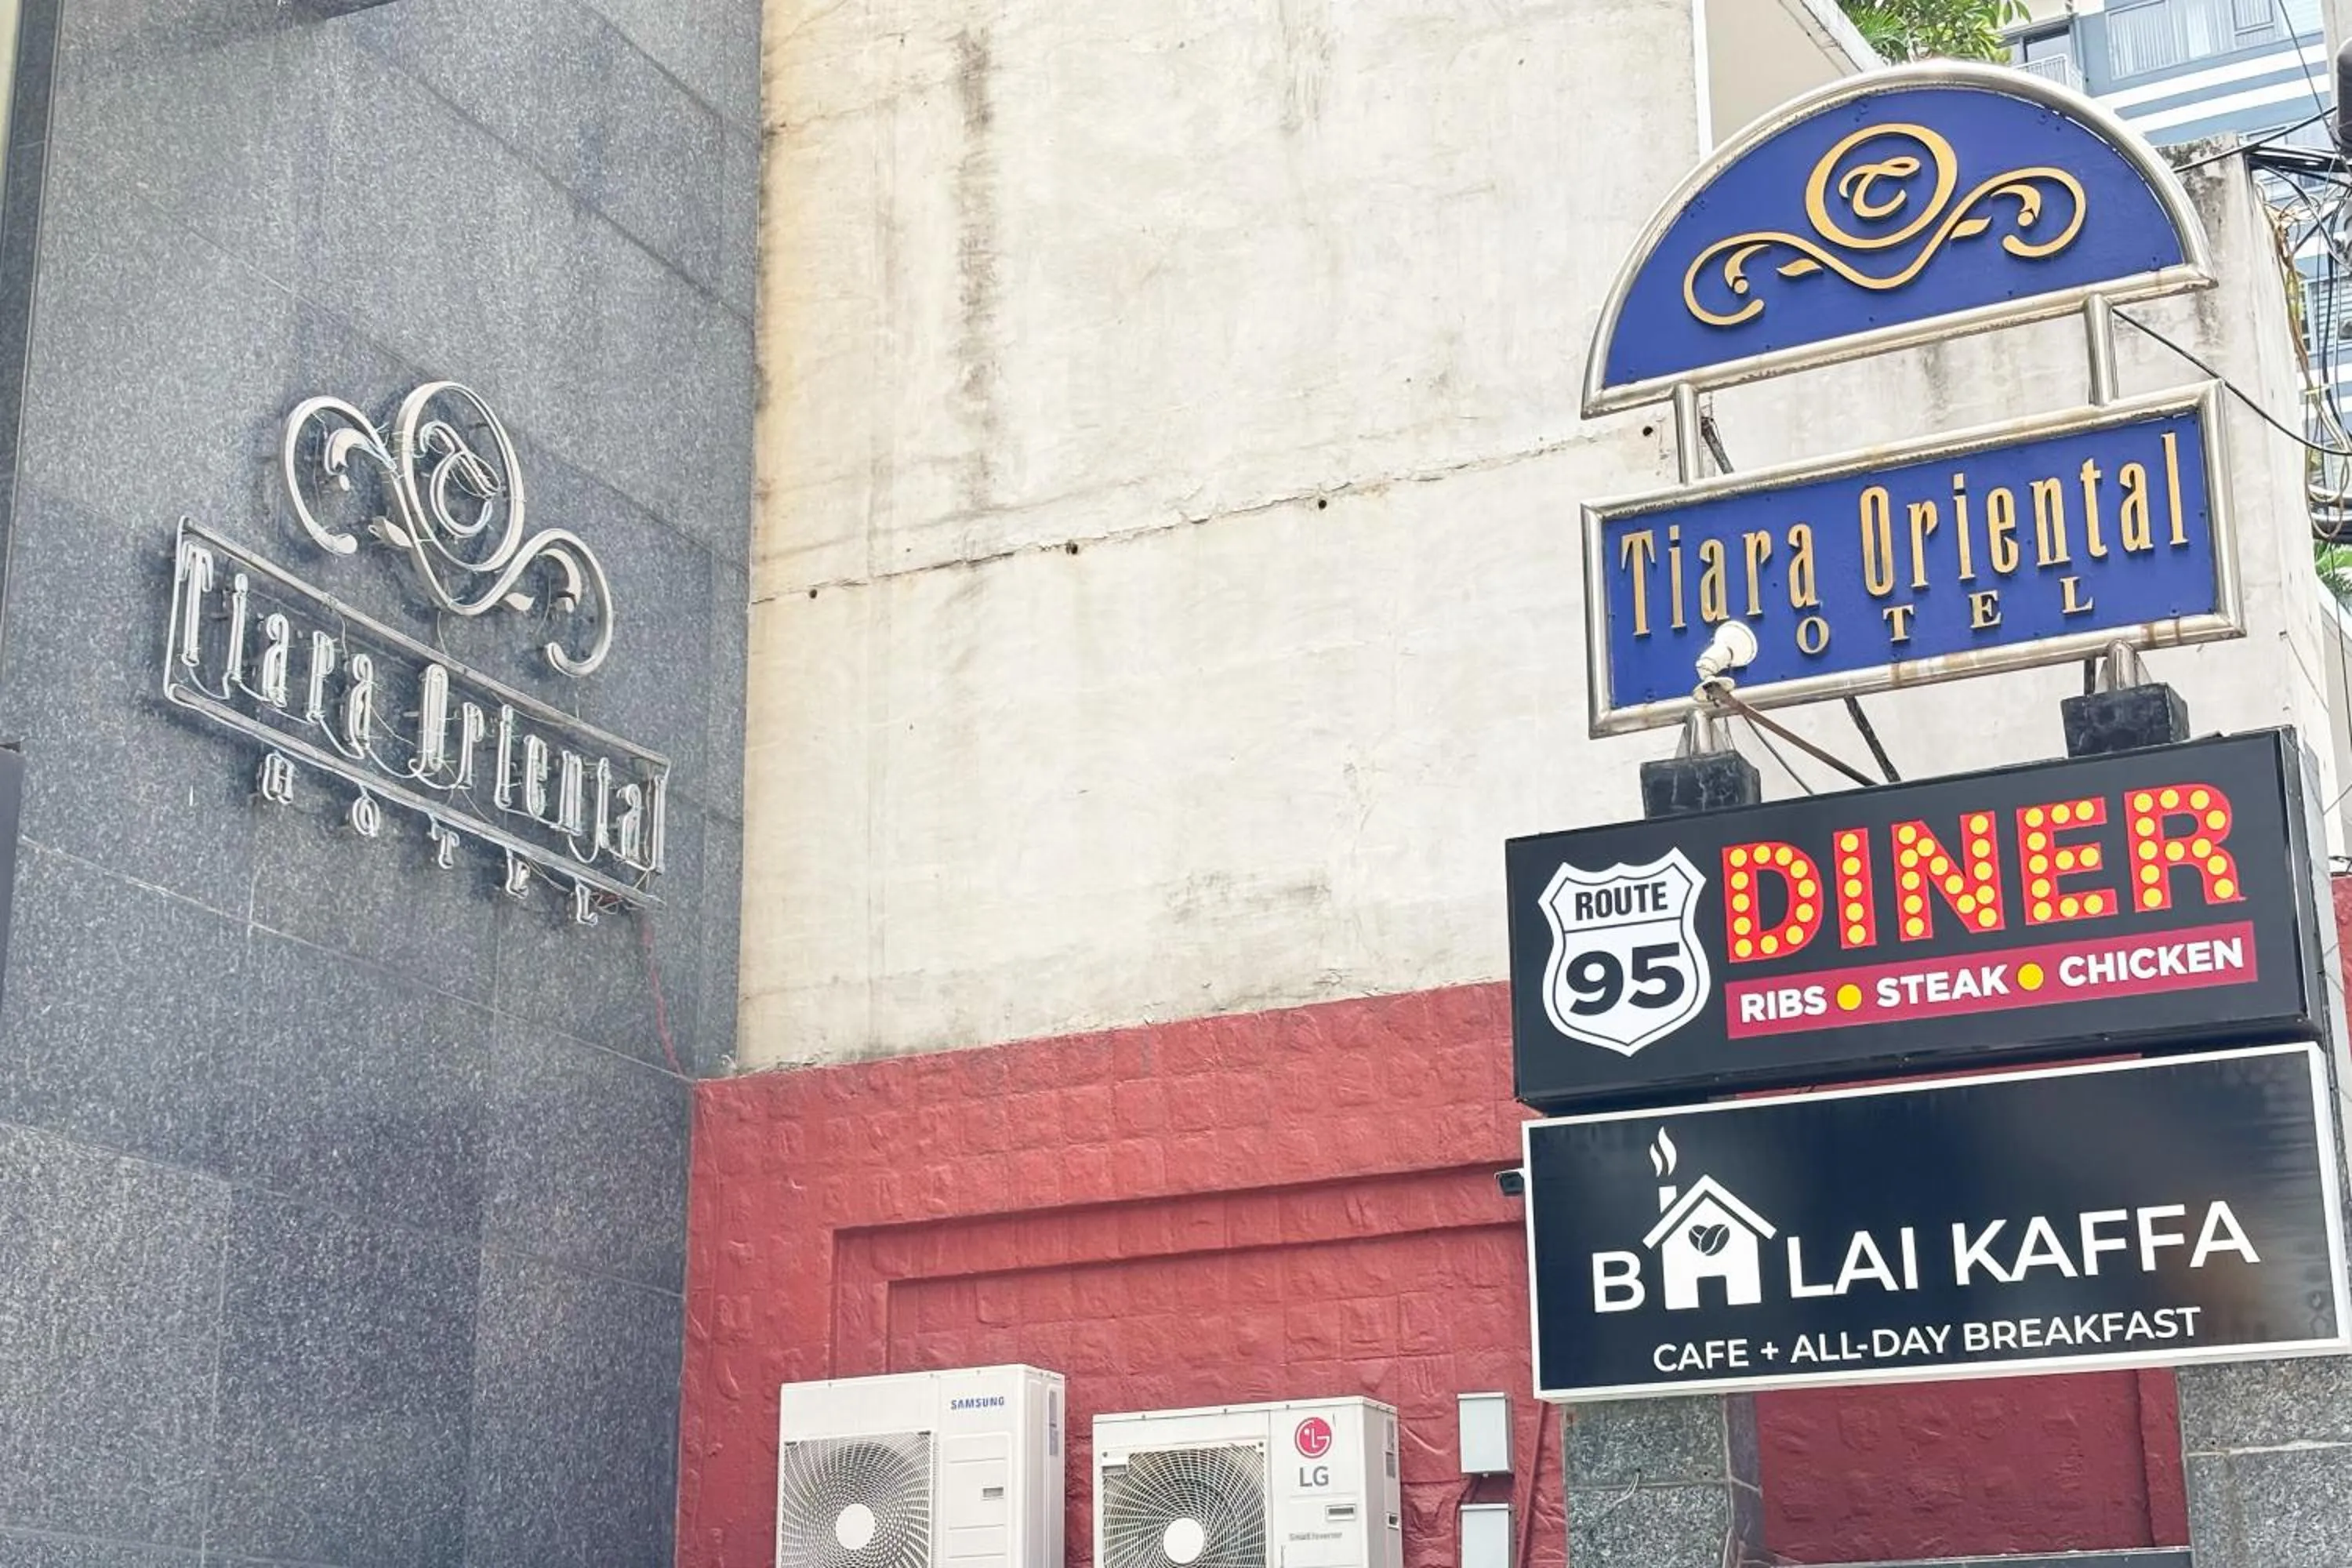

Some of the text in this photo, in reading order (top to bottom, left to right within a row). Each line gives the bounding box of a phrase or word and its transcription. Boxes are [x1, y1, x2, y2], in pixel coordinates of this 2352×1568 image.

[1620, 431, 2189, 637] Tiara Oriental
[1711, 576, 2095, 666] OTEL
[179, 540, 666, 877] Tiara Oriental
[262, 751, 599, 925] HOTEL
[1722, 782, 2246, 964] DINER
[1575, 880, 1670, 920] ROUTE
[1566, 942, 1686, 1016] 95
[1740, 937, 2245, 1023] RIBS STEAK CHICKEN
[1953, 1200, 2260, 1287] KAFFA
[1653, 1338, 1749, 1373] CAFE
[1790, 1322, 1952, 1364] ALL-DAY
[1964, 1305, 2201, 1353] BREAKFAST
[949, 1396, 1005, 1410] SAMSUNG
[1298, 1465, 1330, 1487] LG
